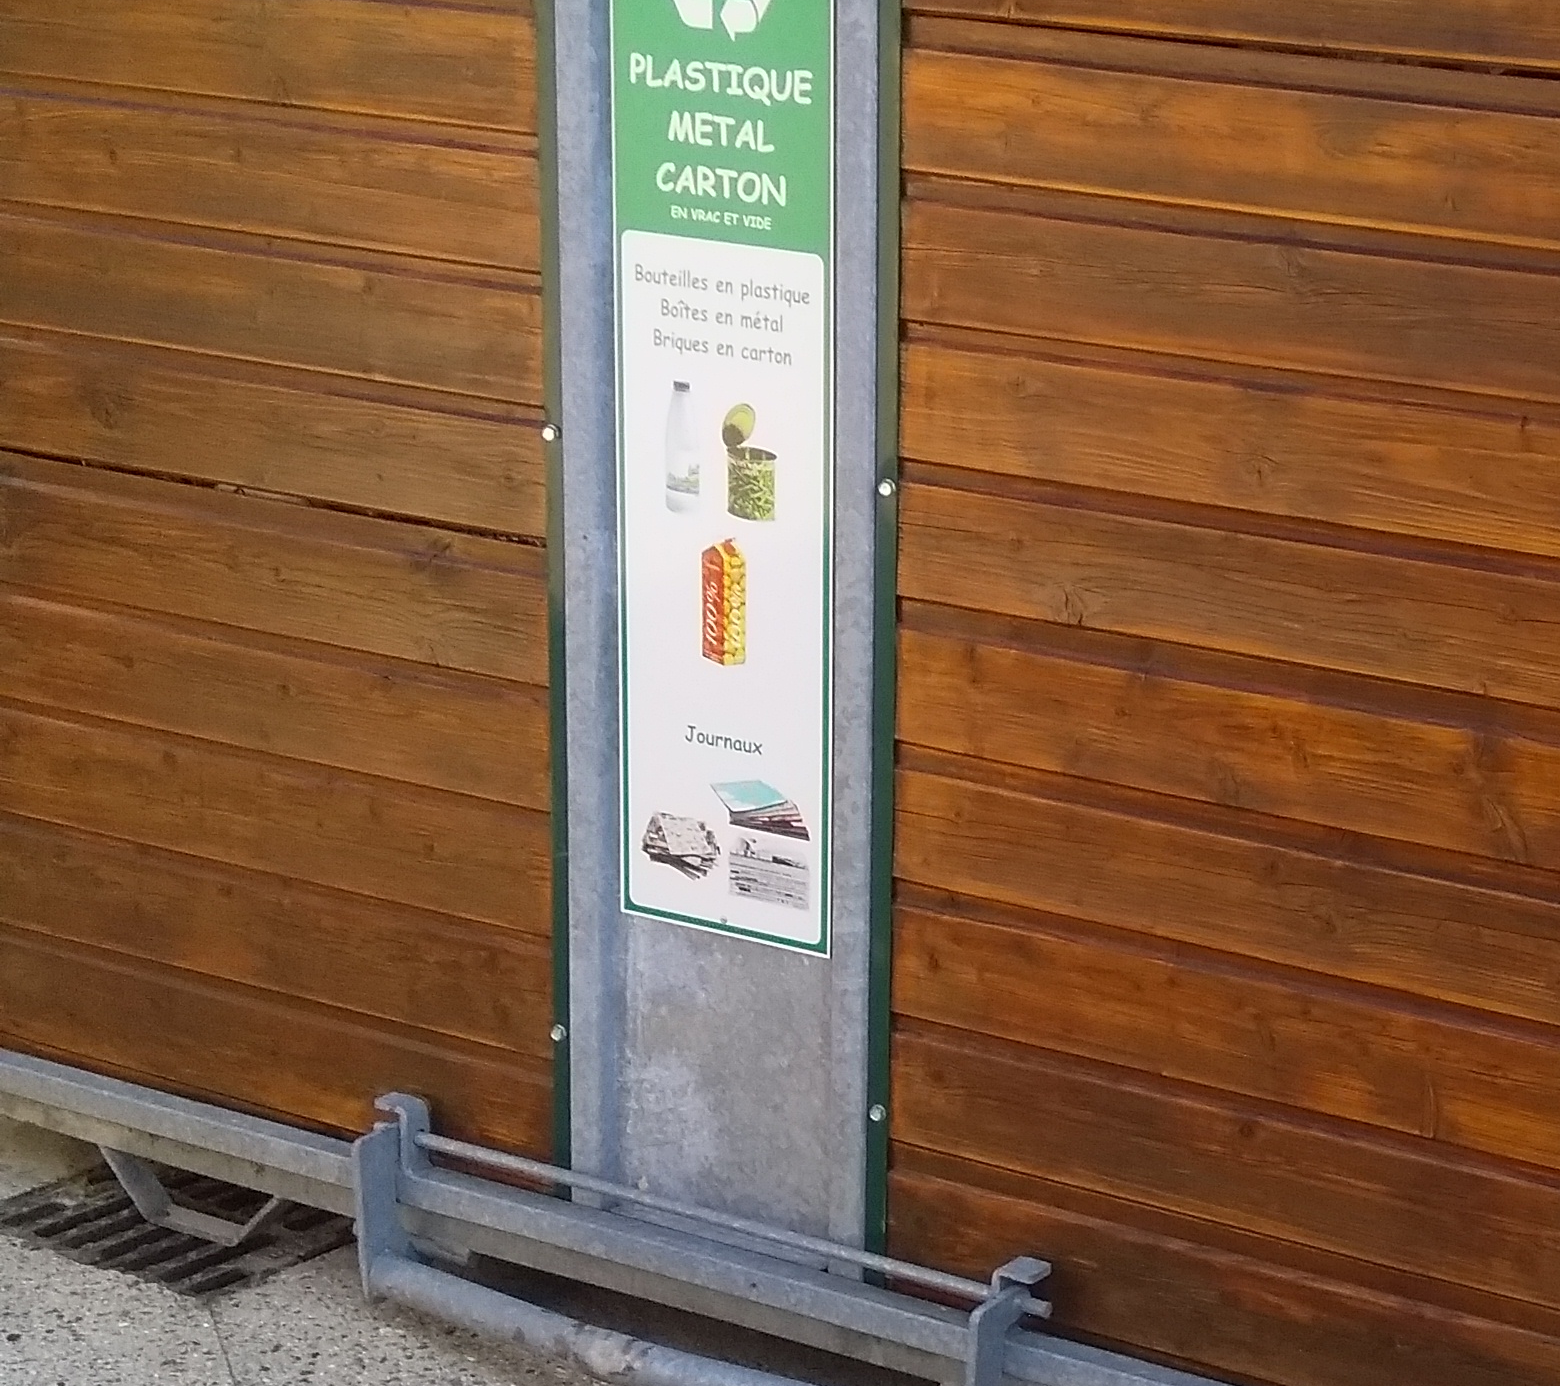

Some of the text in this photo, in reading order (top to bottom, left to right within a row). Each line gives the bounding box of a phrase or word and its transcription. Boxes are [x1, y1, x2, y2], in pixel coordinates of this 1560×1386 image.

[629, 52, 813, 106] PLASTIQUE
[668, 111, 775, 153] METAL
[656, 162, 787, 207] CARTON
[670, 205, 772, 230] EN VRAC ET VIDE
[634, 263, 810, 308] Bouteilles en plastique
[661, 298, 784, 333] Boîtes en métal
[653, 328, 792, 366] Briques en carton
[705, 581, 720, 645] 100%
[684, 724, 763, 755] Journaux
